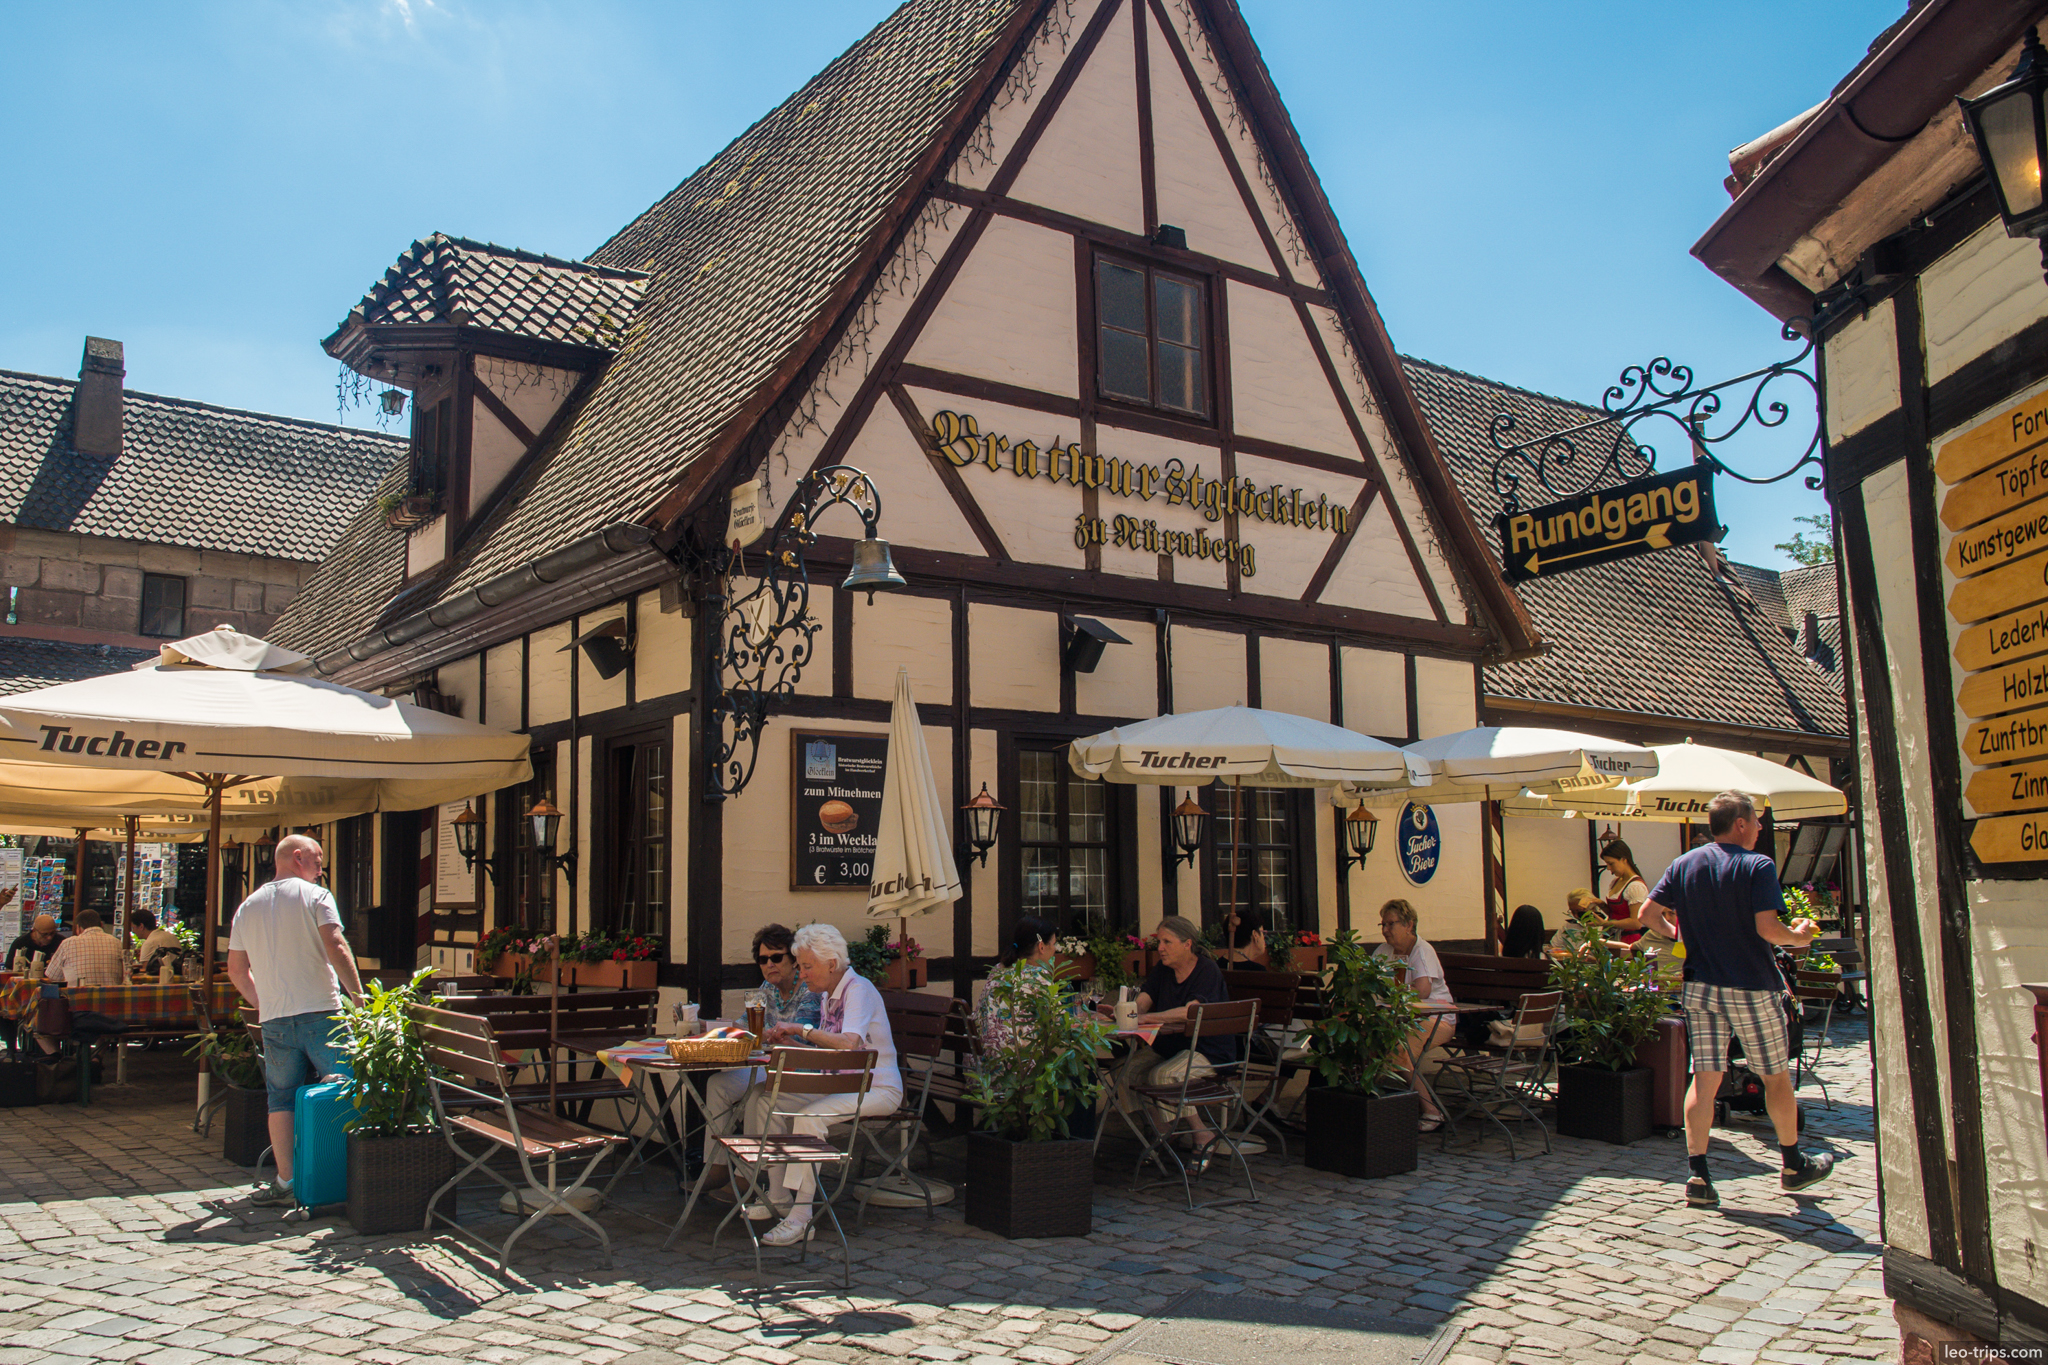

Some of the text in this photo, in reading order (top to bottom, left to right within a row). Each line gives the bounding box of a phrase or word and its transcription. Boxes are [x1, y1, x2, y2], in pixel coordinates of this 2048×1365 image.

[931, 409, 1349, 534] Bratwurstglöcklein
[1996, 454, 2048, 498] Töpfe
[1509, 479, 1700, 554] Rundgang
[1113, 514, 1257, 577] Nürnberg
[1958, 514, 2048, 568] Kunstgewe
[39, 724, 187, 761] Tucher
[1140, 751, 1227, 769] Tucher
[1590, 754, 1631, 772] Tucher
[804, 786, 881, 799] zum Mitnehmen
[1655, 796, 1710, 813] Tuche
[809, 832, 877, 846] 3 im Weckla
[814, 862, 869, 884] € 3,00
[1408, 854, 1436, 875] Biere
